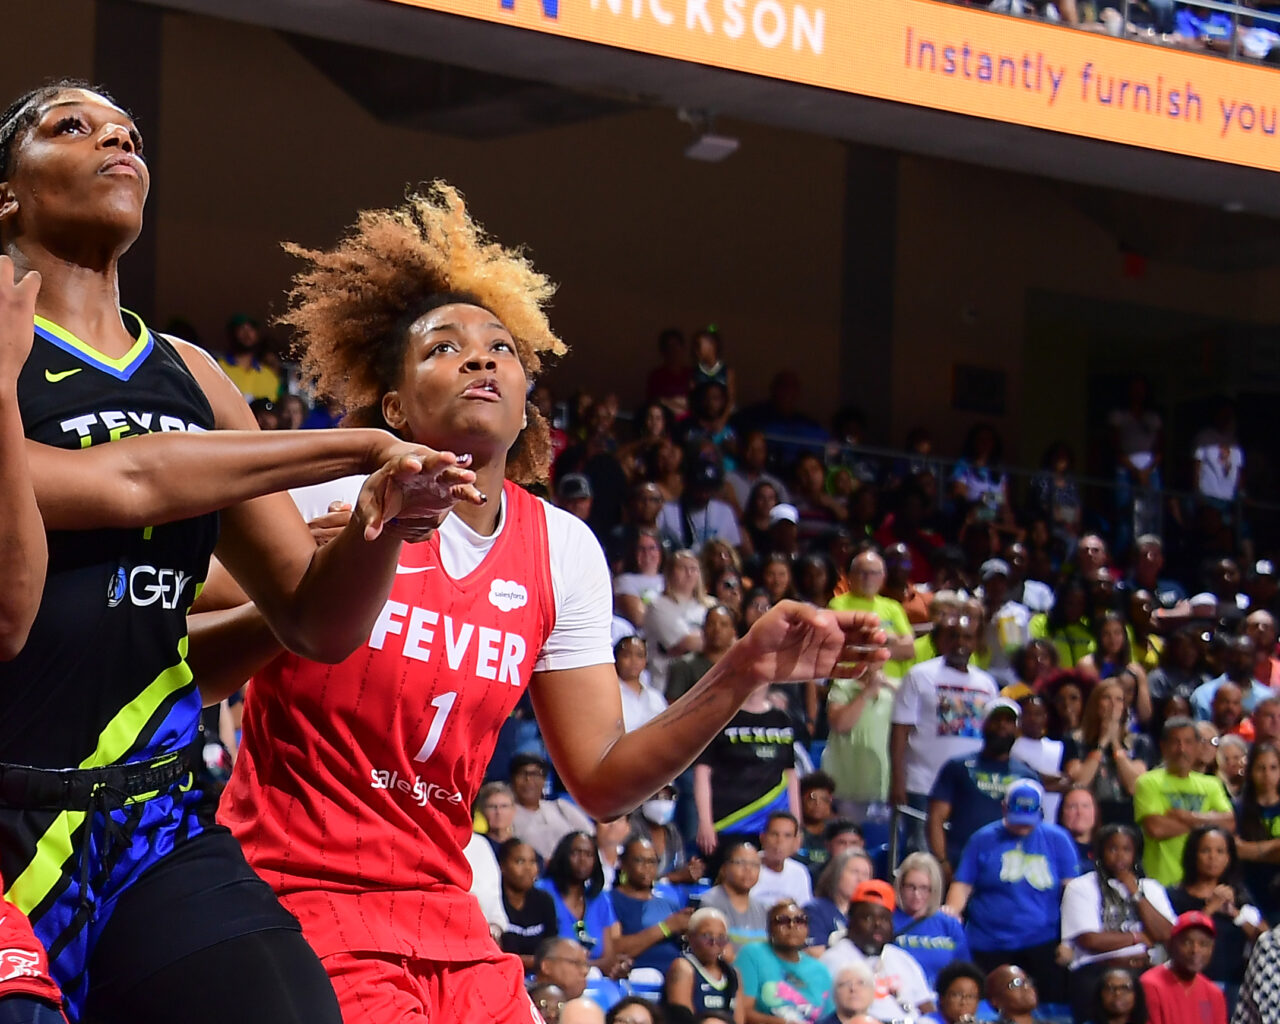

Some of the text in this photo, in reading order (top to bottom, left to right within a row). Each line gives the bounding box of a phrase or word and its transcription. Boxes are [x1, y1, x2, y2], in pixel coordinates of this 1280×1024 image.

[904, 25, 1065, 107] Instantly
[1081, 62, 1203, 123] furnish
[368, 599, 527, 687] FEVER
[413, 691, 458, 763] 1
[724, 727, 794, 744] TEXAS
